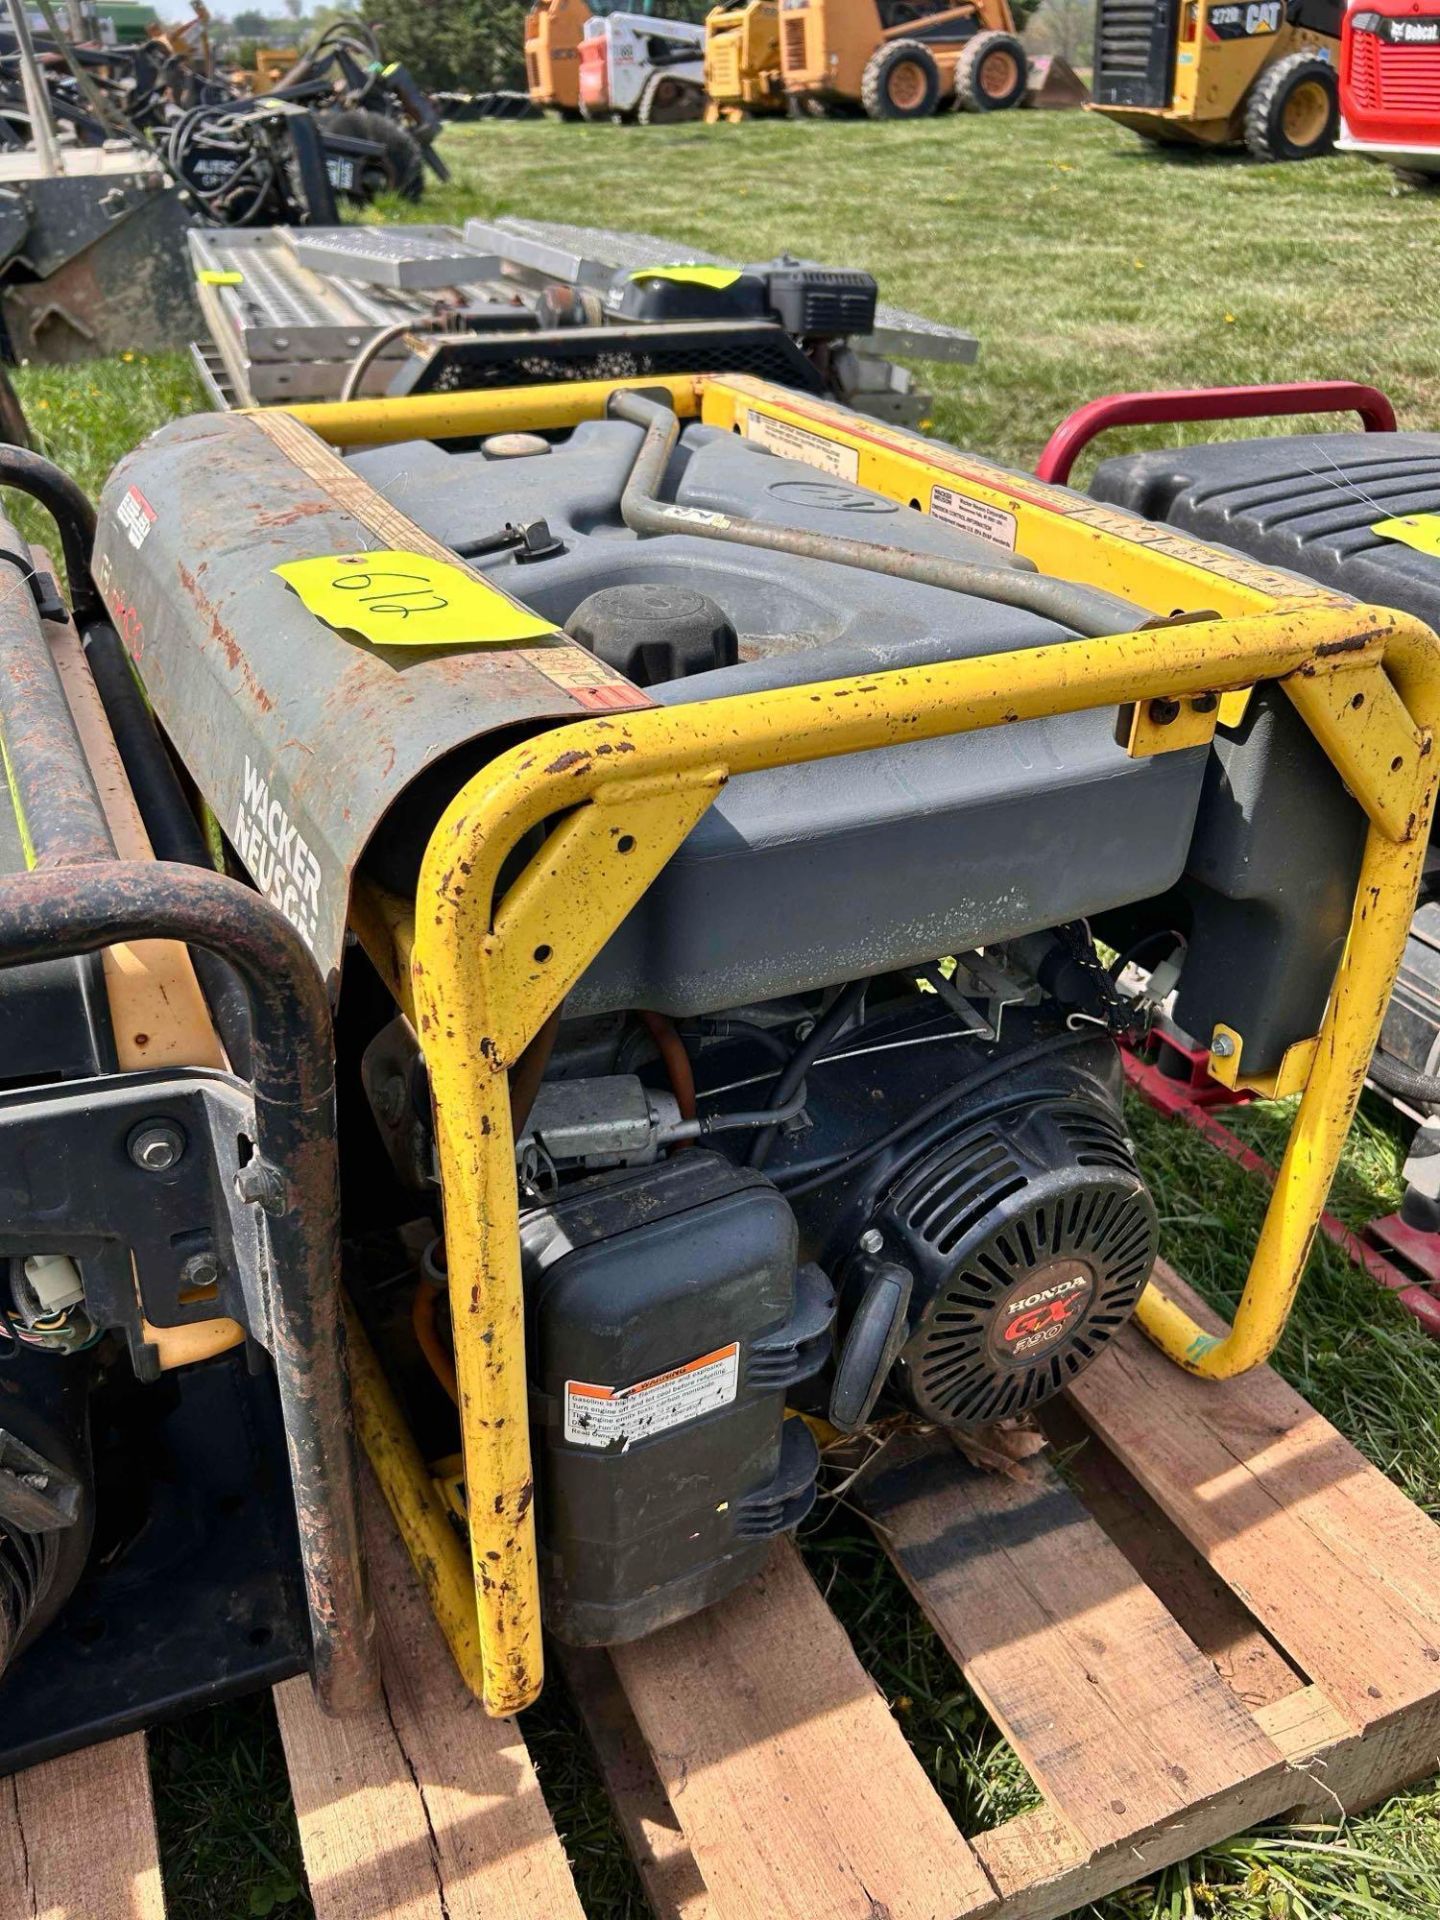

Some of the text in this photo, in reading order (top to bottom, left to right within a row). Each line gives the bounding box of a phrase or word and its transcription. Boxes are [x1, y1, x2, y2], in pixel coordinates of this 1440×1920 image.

[1245, 2, 1281, 34] CAT
[244, 754, 322, 917] WACKER
[1008, 1276, 1087, 1315] HONDA
[1005, 1291, 1082, 1341] GX
[1013, 1323, 1063, 1355] 390
[572, 1395, 604, 1407] Gasoline
[638, 1380, 676, 1398] flammable
[678, 1373, 691, 1384] and
[641, 1368, 687, 1389] WARNING
[572, 1403, 589, 1411] Turn
[590, 1406, 617, 1416] engine
[618, 1406, 629, 1414] off
[631, 1400, 644, 1409] and
[657, 1390, 671, 1400] cool
[672, 1380, 695, 1392] before
[571, 1427, 590, 1437] Read
